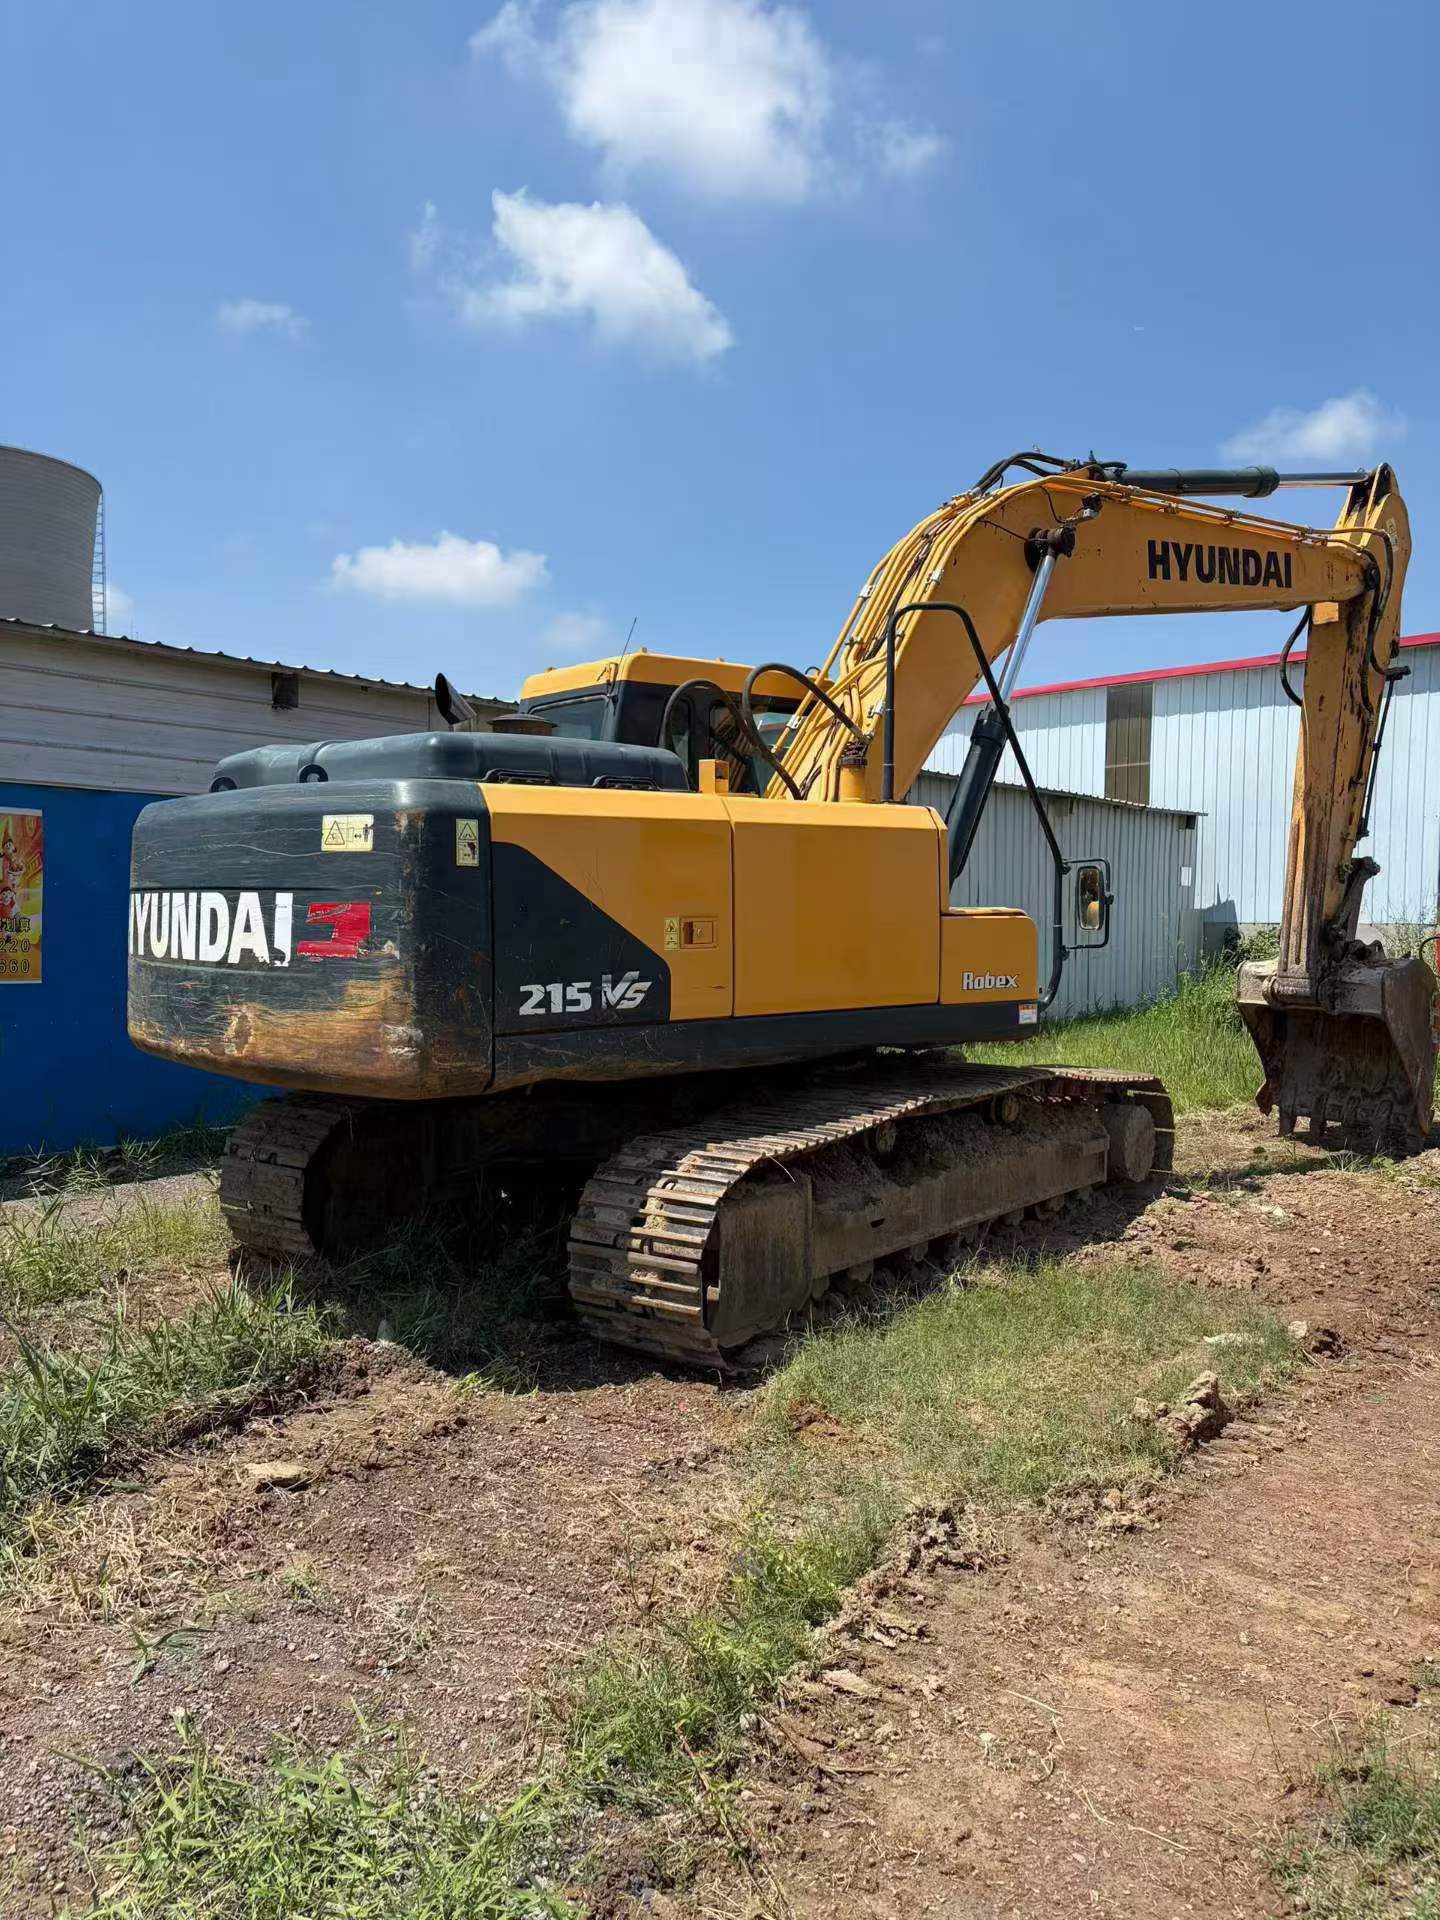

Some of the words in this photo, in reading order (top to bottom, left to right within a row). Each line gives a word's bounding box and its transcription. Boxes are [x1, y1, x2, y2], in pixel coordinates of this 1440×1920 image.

[1147, 539, 1293, 589] HYUNDAI
[518, 981, 592, 1016] 215
[962, 971, 1019, 991] Robex
